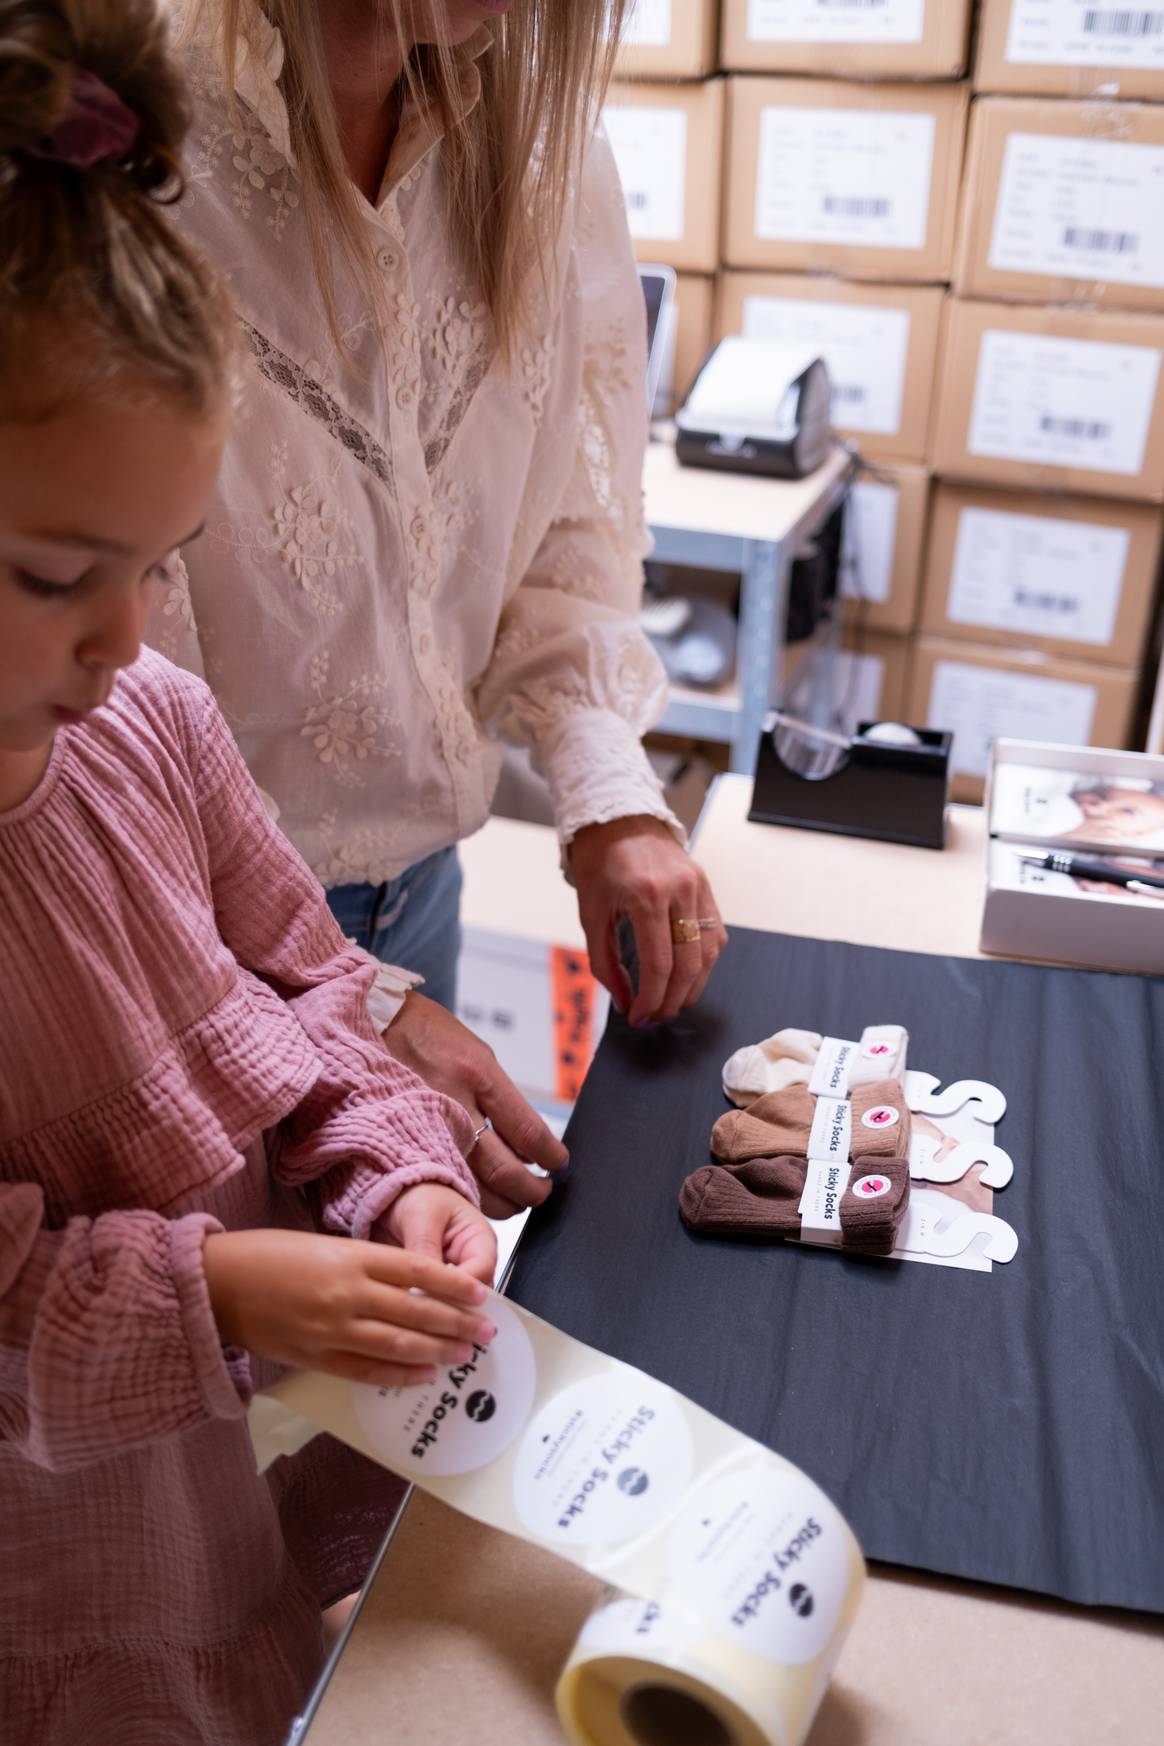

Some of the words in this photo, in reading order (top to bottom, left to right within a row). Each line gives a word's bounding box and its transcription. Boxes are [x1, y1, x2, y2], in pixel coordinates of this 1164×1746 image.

[829, 1126, 843, 1151] Socks
[832, 1104, 847, 1124] Sticky
[824, 1167, 840, 1191] Sticky
[824, 1192, 837, 1219] Socks
[411, 1392, 458, 1458] Socks
[602, 1405, 655, 1464] Sticky
[558, 1467, 608, 1527] Socks
[774, 1517, 822, 1571] Sticky
[732, 1571, 781, 1626] Socks
